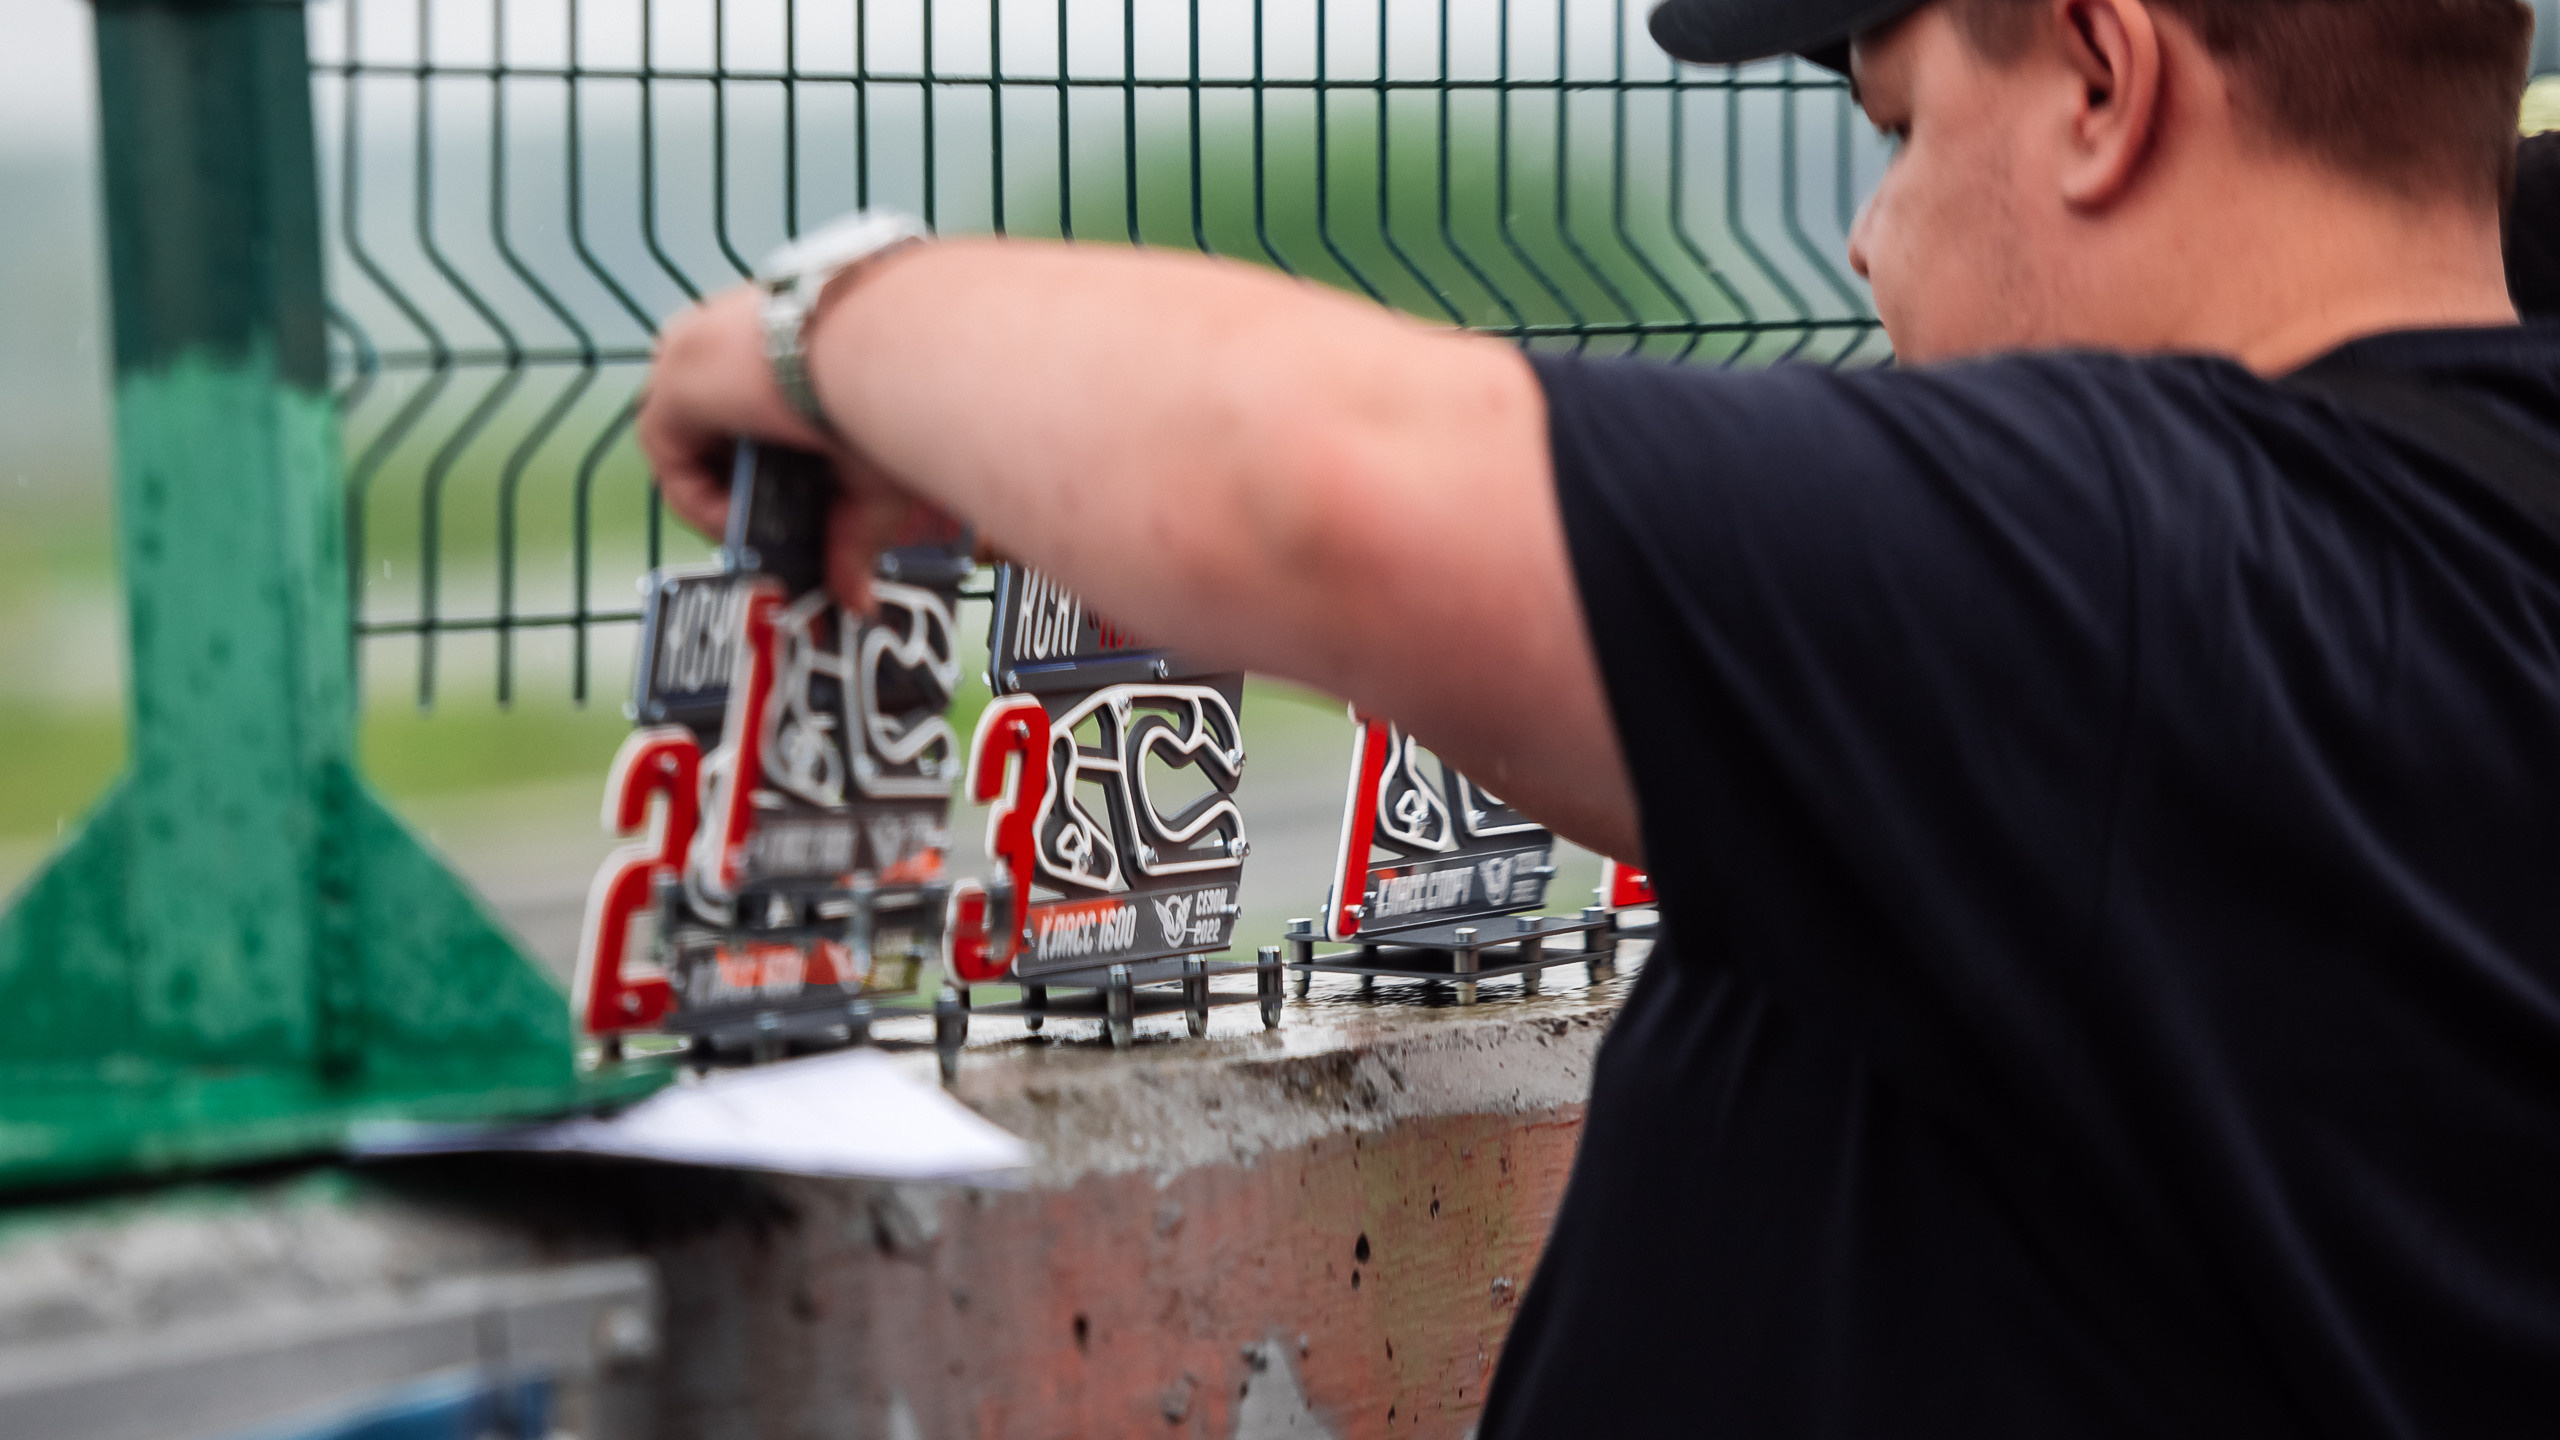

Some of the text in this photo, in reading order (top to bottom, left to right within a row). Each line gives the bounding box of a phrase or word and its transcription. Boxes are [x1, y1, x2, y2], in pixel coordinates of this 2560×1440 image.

[576, 727, 699, 1033] 2
[946, 694, 1050, 988] 3
[1037, 905, 1137, 962] КЛАСС 1600
[1193, 917, 1221, 945] 2022
